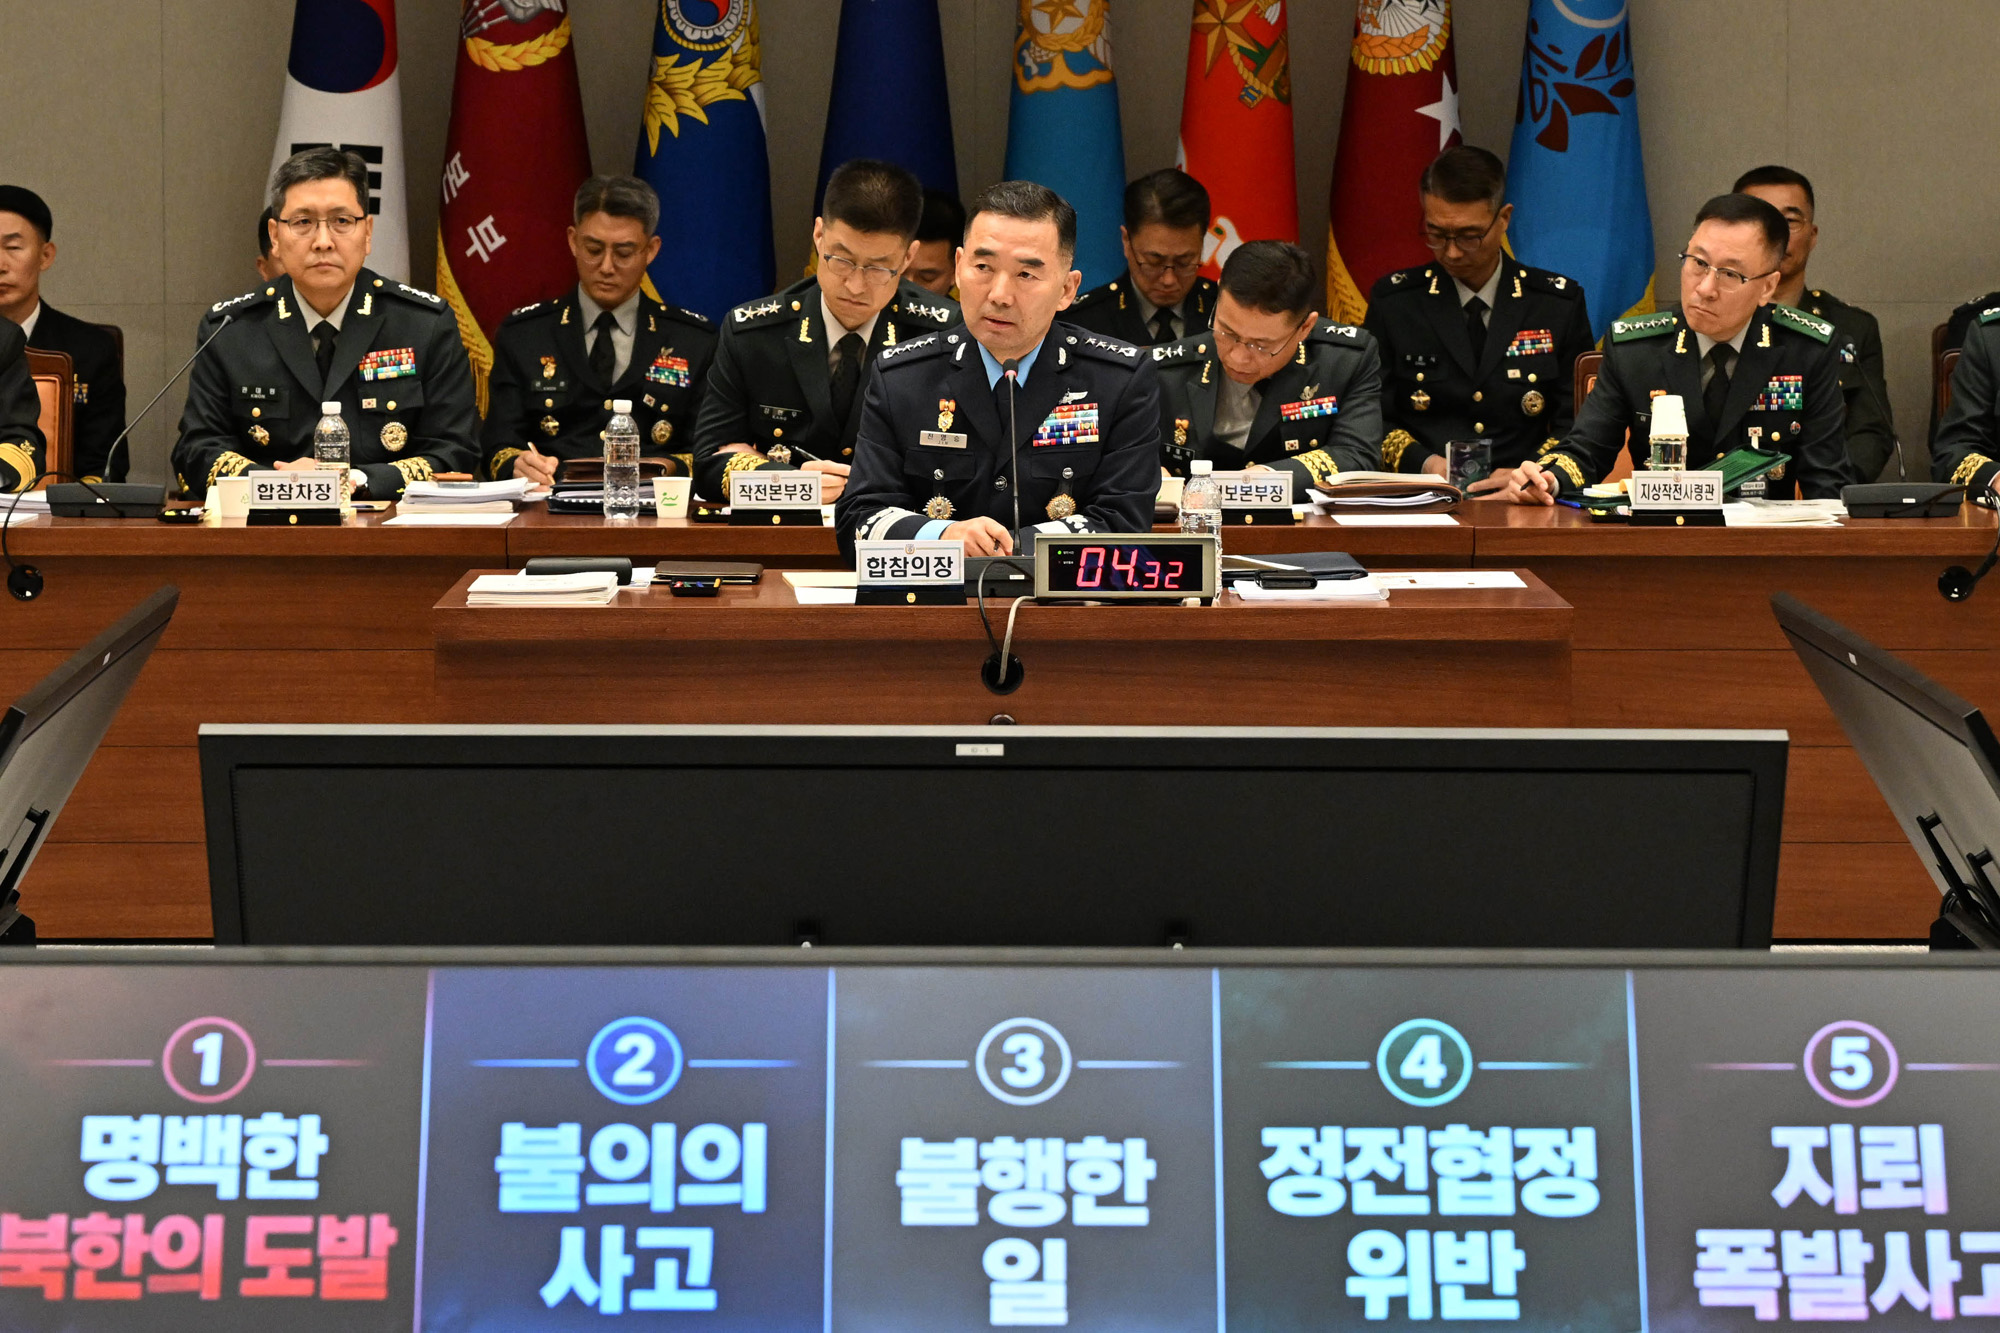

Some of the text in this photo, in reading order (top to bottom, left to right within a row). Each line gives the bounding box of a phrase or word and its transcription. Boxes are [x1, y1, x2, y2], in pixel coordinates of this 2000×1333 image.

[257, 483, 332, 501] 합참차장
[739, 483, 813, 502] 작전본부장
[1219, 485, 1284, 503] 보본부장
[1640, 483, 1715, 501] 지상작전사령관
[866, 556, 954, 578] 합참의장
[193, 1032, 223, 1088] 1
[612, 1032, 656, 1087] 2
[1000, 1033, 1046, 1089] 3
[1400, 1034, 1447, 1090] 4
[1829, 1035, 1872, 1091] 5
[80, 1112, 329, 1201] 명백한
[494, 1122, 768, 1213] 불의의
[896, 1136, 1157, 1227] 불행한
[1259, 1124, 1600, 1218] 정전협정
[1771, 1124, 1948, 1214] 지뢰
[0, 1212, 398, 1300] 북한의 도발
[539, 1225, 718, 1316] 사고
[982, 1238, 1069, 1326] 일
[1346, 1230, 1526, 1320] 위반
